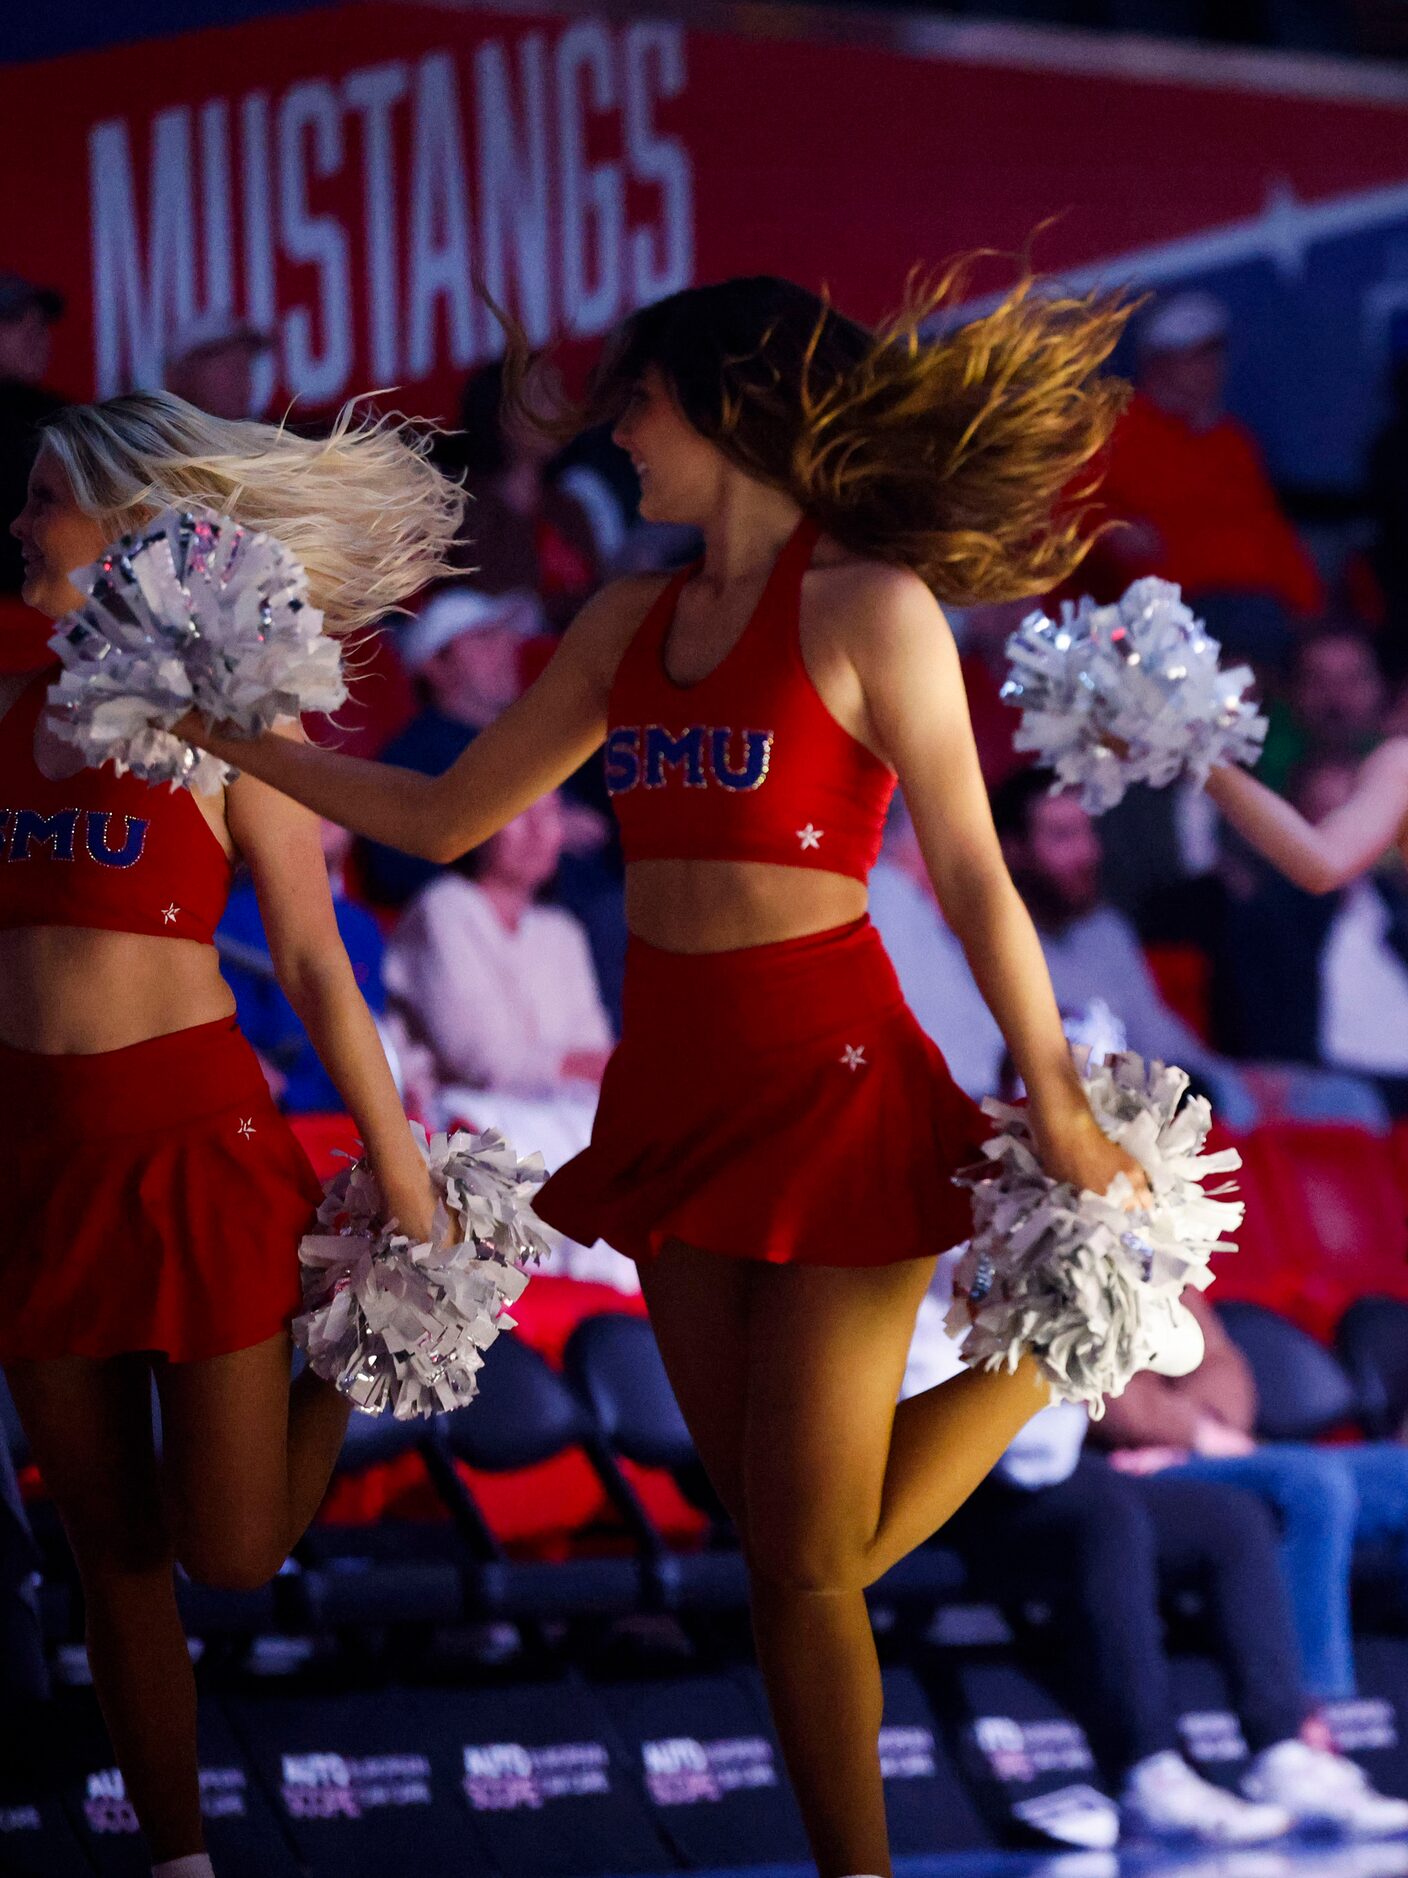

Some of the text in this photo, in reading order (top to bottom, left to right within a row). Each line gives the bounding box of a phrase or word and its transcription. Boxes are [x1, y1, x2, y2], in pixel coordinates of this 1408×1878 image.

[86, 18, 696, 418] MUSTANGS
[604, 723, 774, 795] SMU
[0, 808, 150, 870] MU
